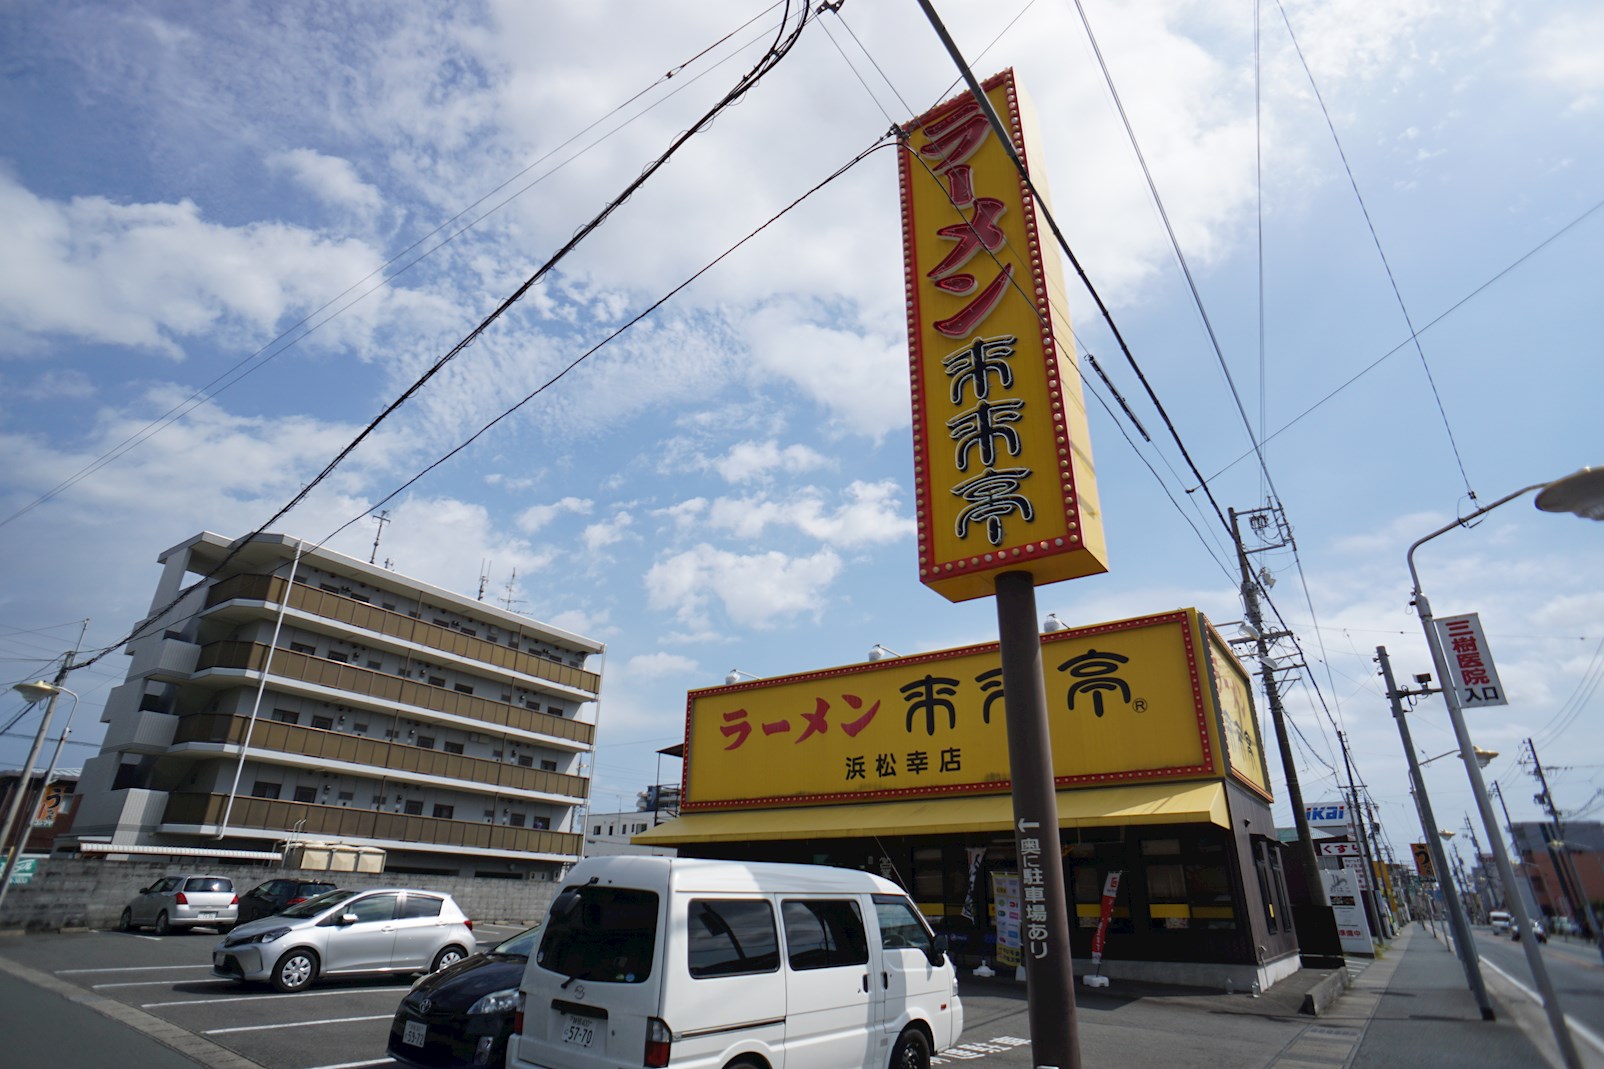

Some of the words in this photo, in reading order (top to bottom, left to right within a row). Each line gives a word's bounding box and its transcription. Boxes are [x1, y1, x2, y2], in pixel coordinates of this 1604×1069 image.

[919, 101, 1015, 340] ラーメン
[1445, 619, 1490, 686] 三樹医院
[719, 693, 882, 752] ラーメン
[1464, 686, 1500, 703] 入口
[845, 746, 963, 782] 浜松幸店
[1020, 837, 1048, 960] 奥に駐車場あり
[568, 1026, 593, 1044] 57-70
